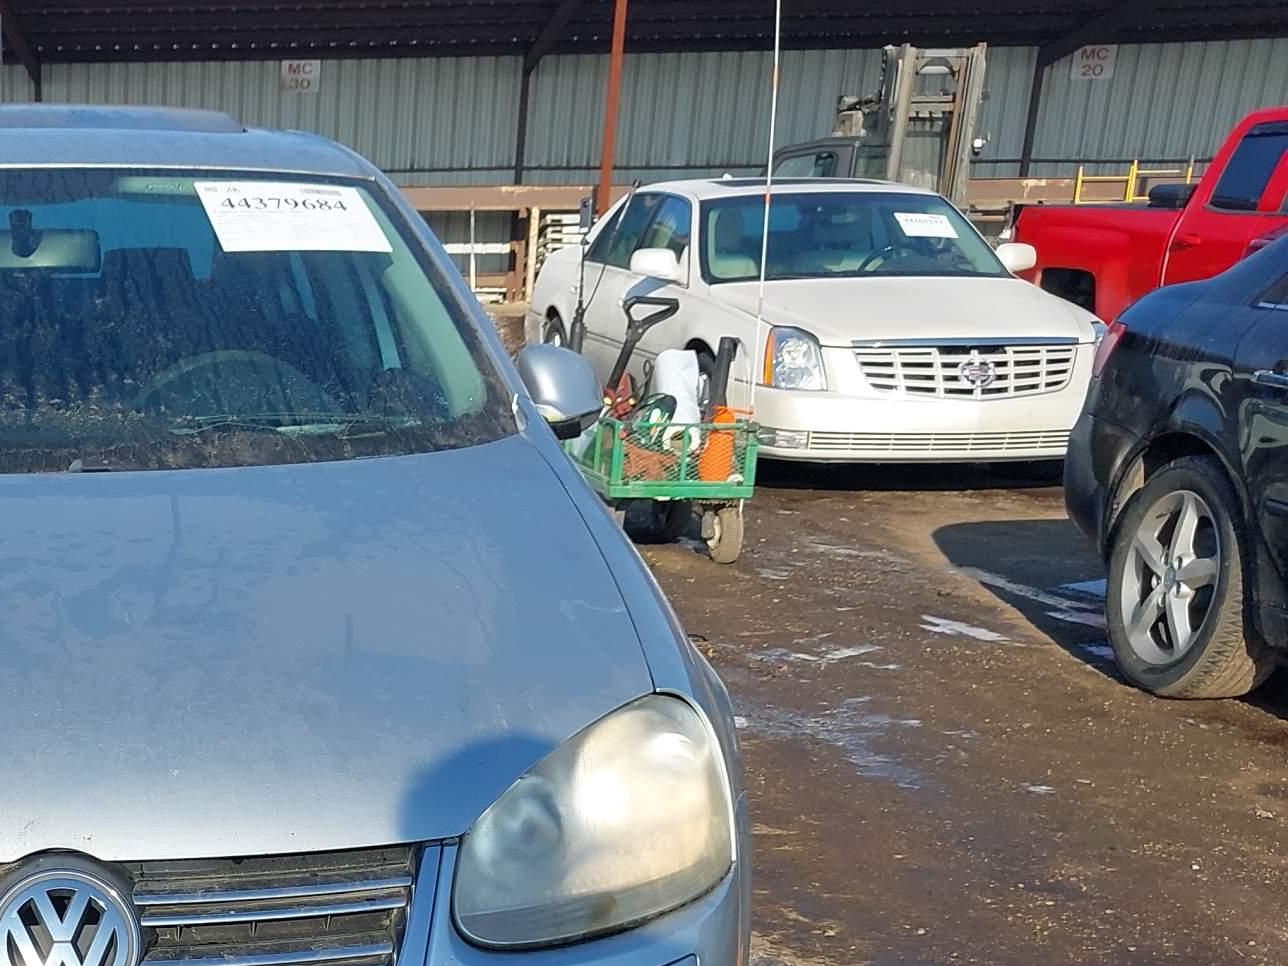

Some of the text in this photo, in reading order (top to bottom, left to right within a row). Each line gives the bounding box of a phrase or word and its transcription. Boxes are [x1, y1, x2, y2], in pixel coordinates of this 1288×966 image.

[1080, 47, 1110, 61] MC
[287, 62, 313, 75] MC
[1080, 64, 1104, 77] 20
[289, 77, 312, 91] 30
[220, 196, 348, 211] 44379684
